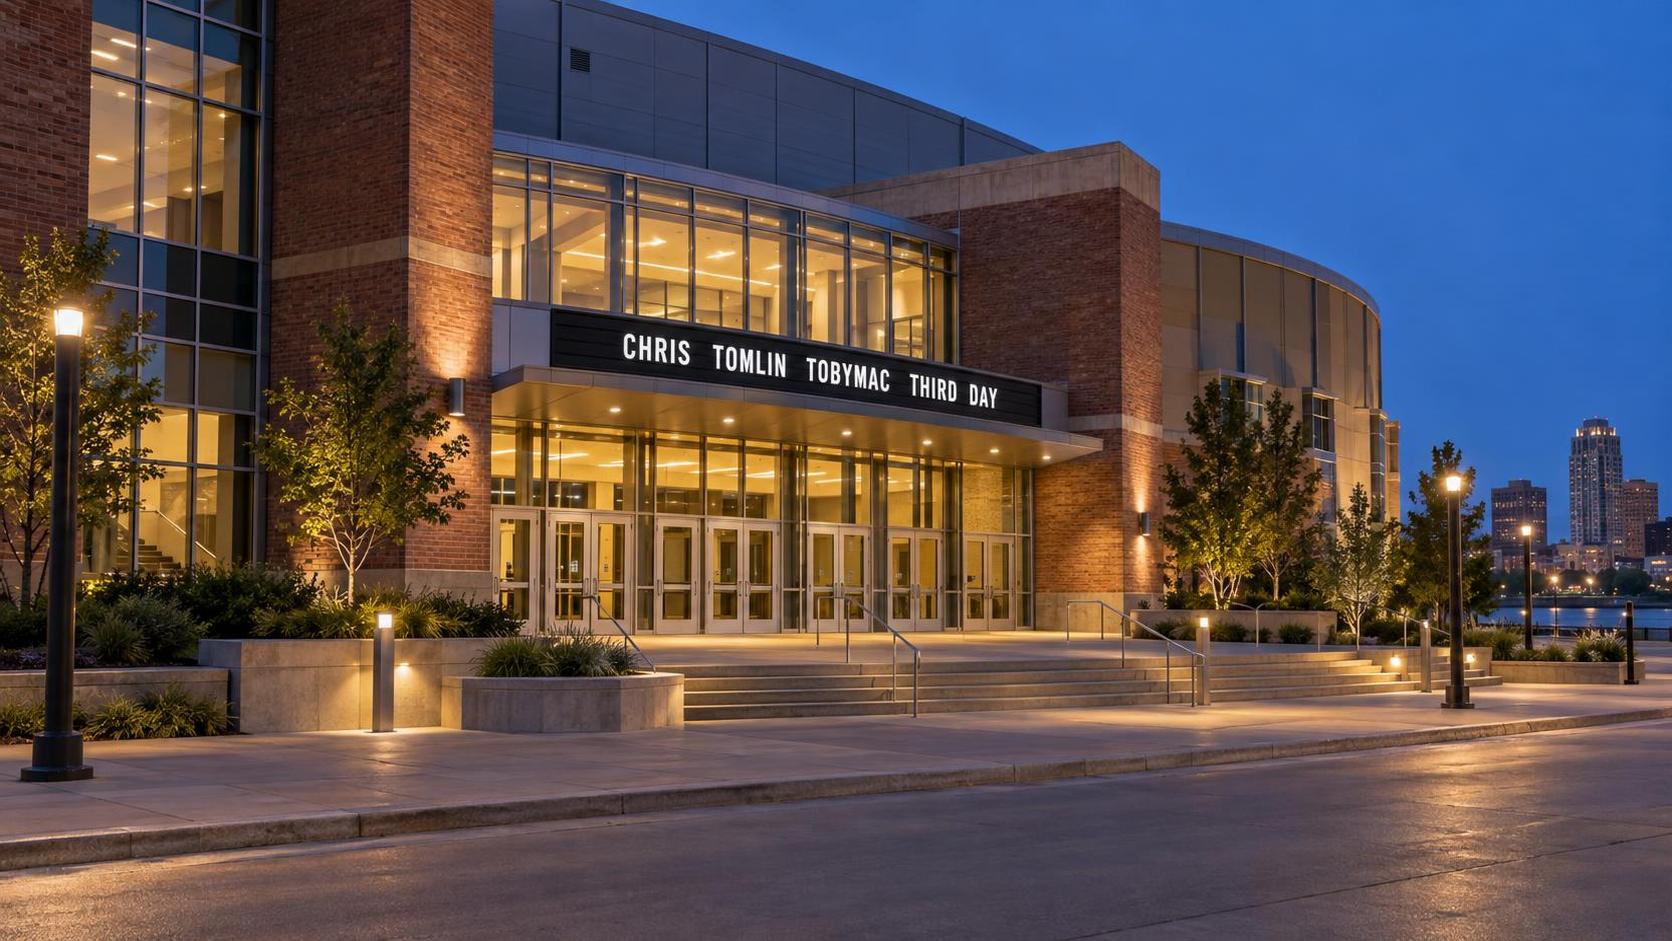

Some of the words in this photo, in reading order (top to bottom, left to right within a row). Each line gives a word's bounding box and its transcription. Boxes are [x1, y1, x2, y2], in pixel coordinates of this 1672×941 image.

[622, 333, 691, 366] CHRIS
[712, 344, 787, 378] TOMLIN
[806, 357, 890, 393] TOBYMAC
[909, 373, 958, 403] THIRD
[969, 383, 998, 409] DAY
